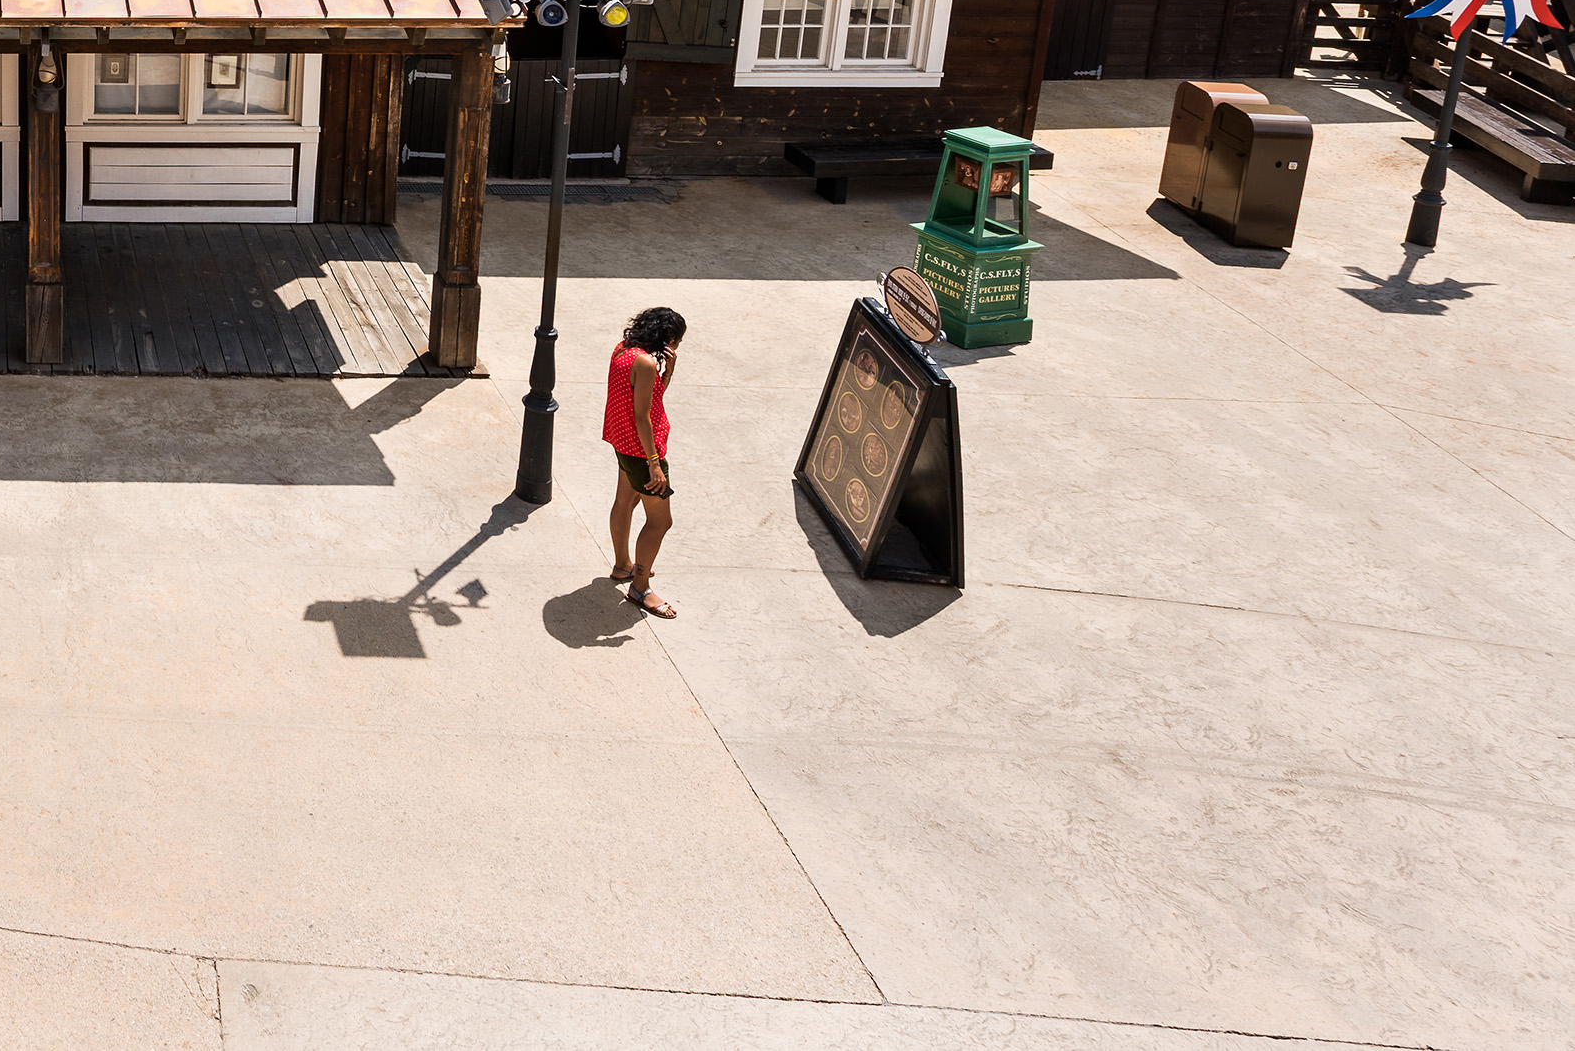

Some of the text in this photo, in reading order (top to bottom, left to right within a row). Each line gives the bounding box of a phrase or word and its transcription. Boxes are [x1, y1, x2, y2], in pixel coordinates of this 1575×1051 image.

[923, 267, 965, 291] PICTURES
[964, 269, 974, 310] STUDIOS
[970, 267, 981, 314] PHOTOGRAPHS
[978, 283, 1020, 294] PICTURES
[978, 293, 1017, 304] GALLERY
